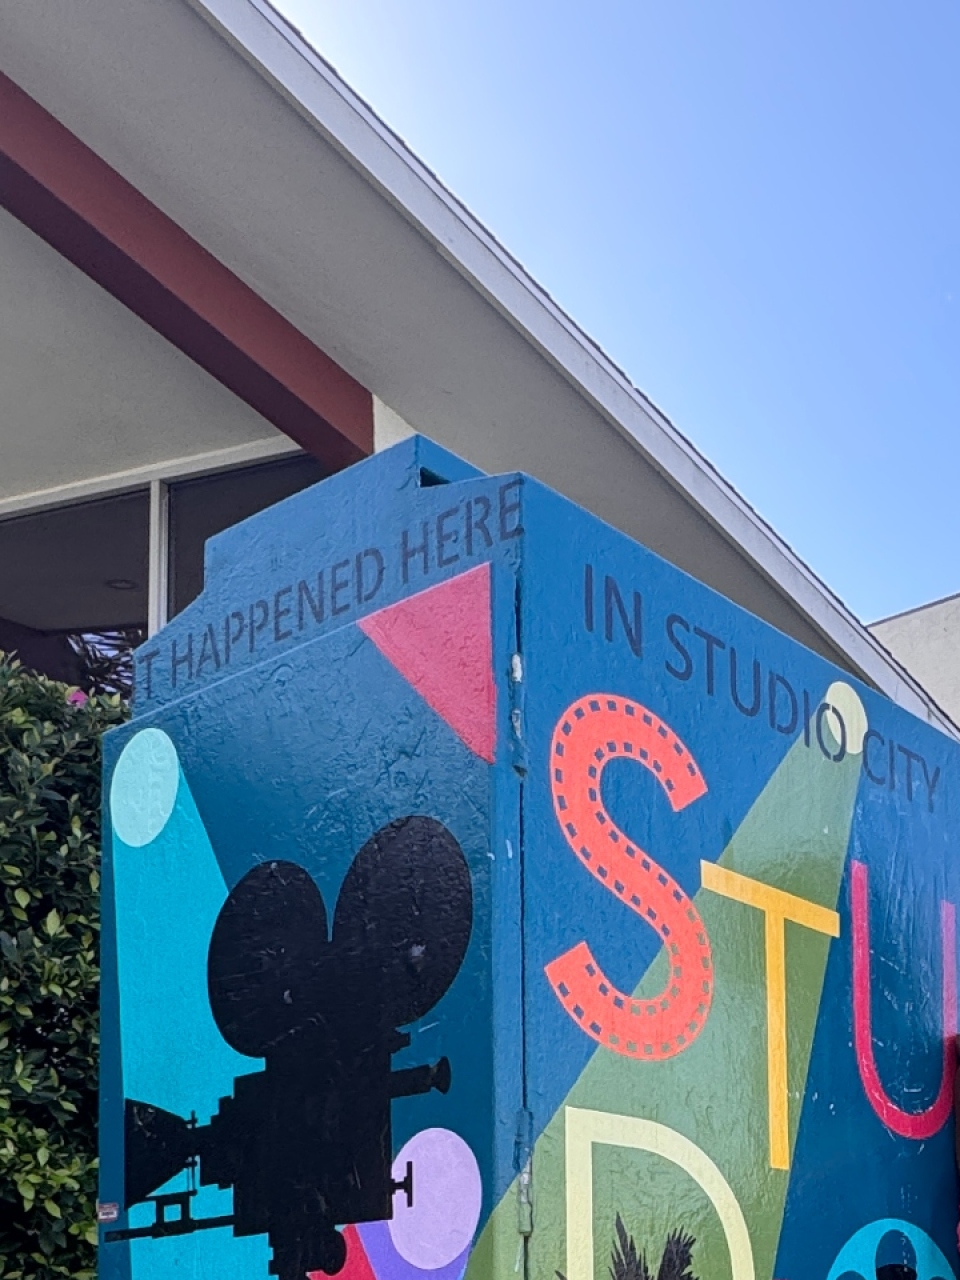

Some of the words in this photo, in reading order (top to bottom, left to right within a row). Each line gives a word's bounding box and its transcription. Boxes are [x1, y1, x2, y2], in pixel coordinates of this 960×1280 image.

[171, 547, 386, 690] HAPPENED
[401, 478, 526, 585] HERE
[584, 563, 643, 659] IN
[664, 613, 847, 763] STUDIO
[862, 728, 941, 814] CITY
